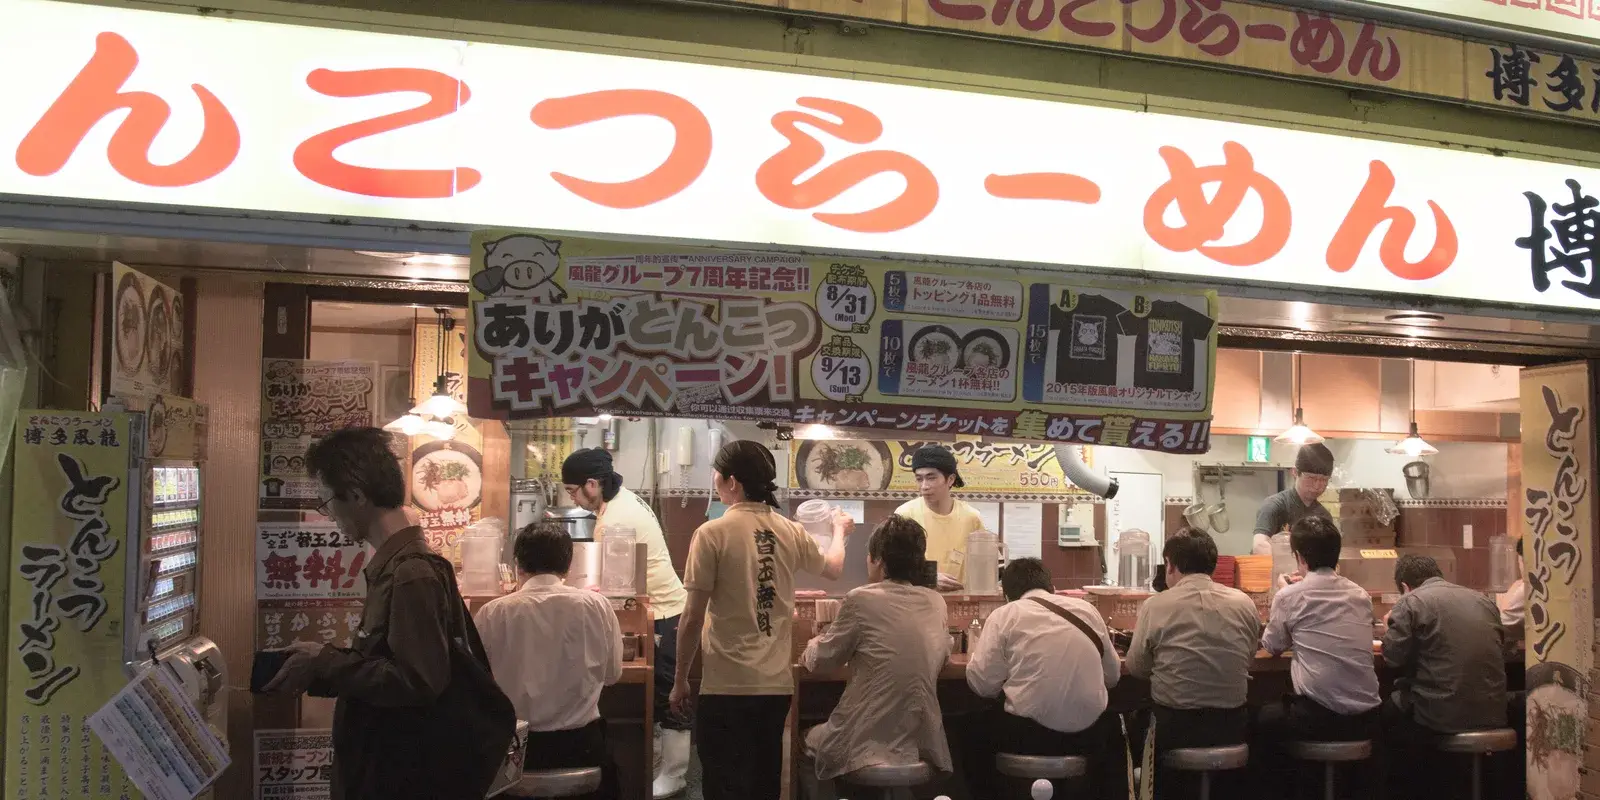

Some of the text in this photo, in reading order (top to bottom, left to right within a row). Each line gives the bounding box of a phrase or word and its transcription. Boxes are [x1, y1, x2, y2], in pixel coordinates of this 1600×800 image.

[1486, 42, 1600, 114] 博多
[15, 31, 1458, 281] んこつらーめん
[688, 255, 801, 264] ANNIVERSARY CAMPAIGN
[569, 264, 810, 291] 風龍グループ7周年記念!!
[888, 274, 901, 305] 5枚で
[827, 285, 867, 315] 8/31
[913, 287, 1016, 309] トッピング1品無料
[1060, 289, 1071, 308] A
[1134, 296, 1144, 314] B
[484, 300, 810, 353] ありがとんこつ
[835, 313, 856, 322] (Mon)
[882, 336, 901, 378] 10枚で
[1028, 324, 1047, 364] 15枚で
[500, 354, 787, 402] キャンペーン!
[821, 357, 861, 386] 9/13
[829, 384, 850, 394] (Sun)
[28, 414, 114, 428] とんこつラーメン
[24, 427, 121, 447] 博多風龍
[1019, 472, 1059, 487] 550円
[261, 531, 297, 540] ラーメン
[261, 549, 366, 589] 無料!
[754, 528, 776, 637] 替玉無料
